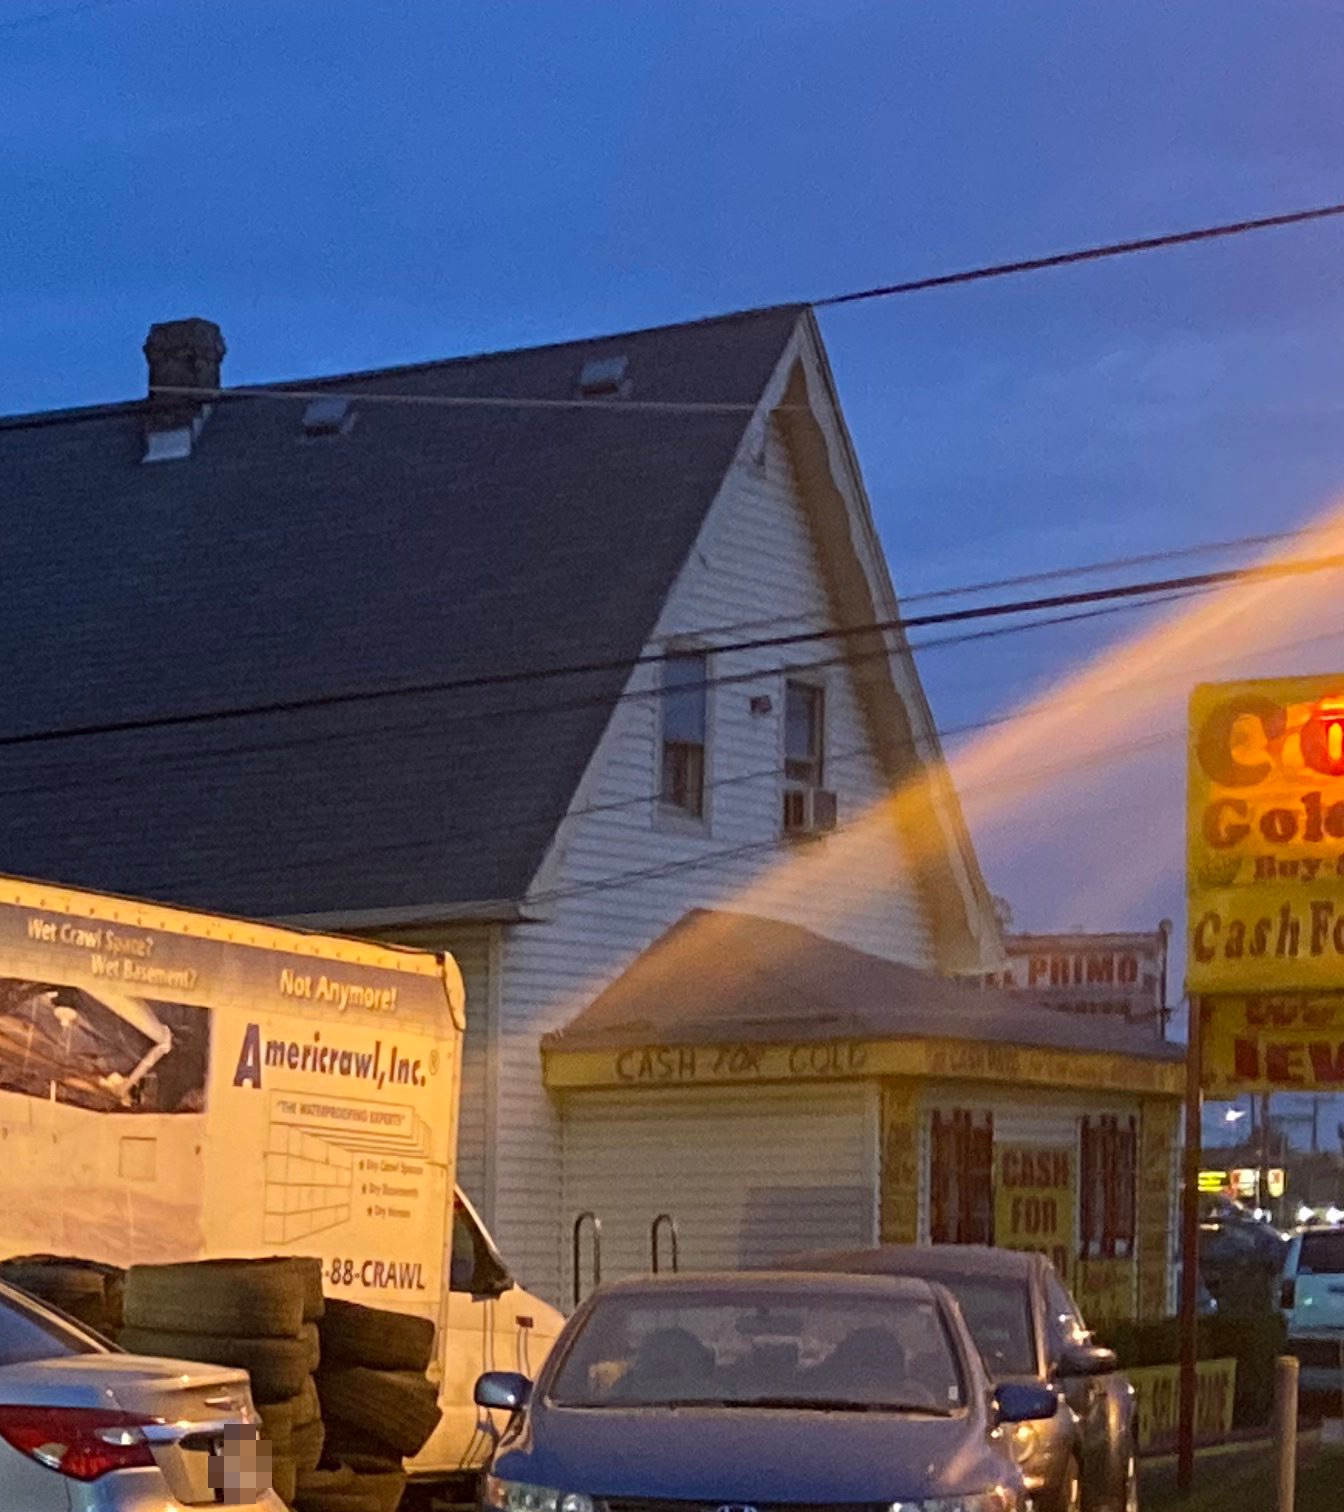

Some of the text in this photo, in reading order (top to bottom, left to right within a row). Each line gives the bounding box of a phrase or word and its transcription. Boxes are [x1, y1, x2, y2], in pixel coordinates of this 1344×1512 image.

[27, 915, 155, 957] Wet Crawl Space?
[1193, 899, 1301, 964] Cash
[91, 953, 198, 989] Wet Basement?
[1028, 953, 1138, 984] PRIMO
[279, 968, 398, 1012] Not Anymore!
[615, 1045, 697, 1082] CASH
[1002, 1149, 1070, 1188] CASH
[1011, 1196, 1058, 1235] FOR
